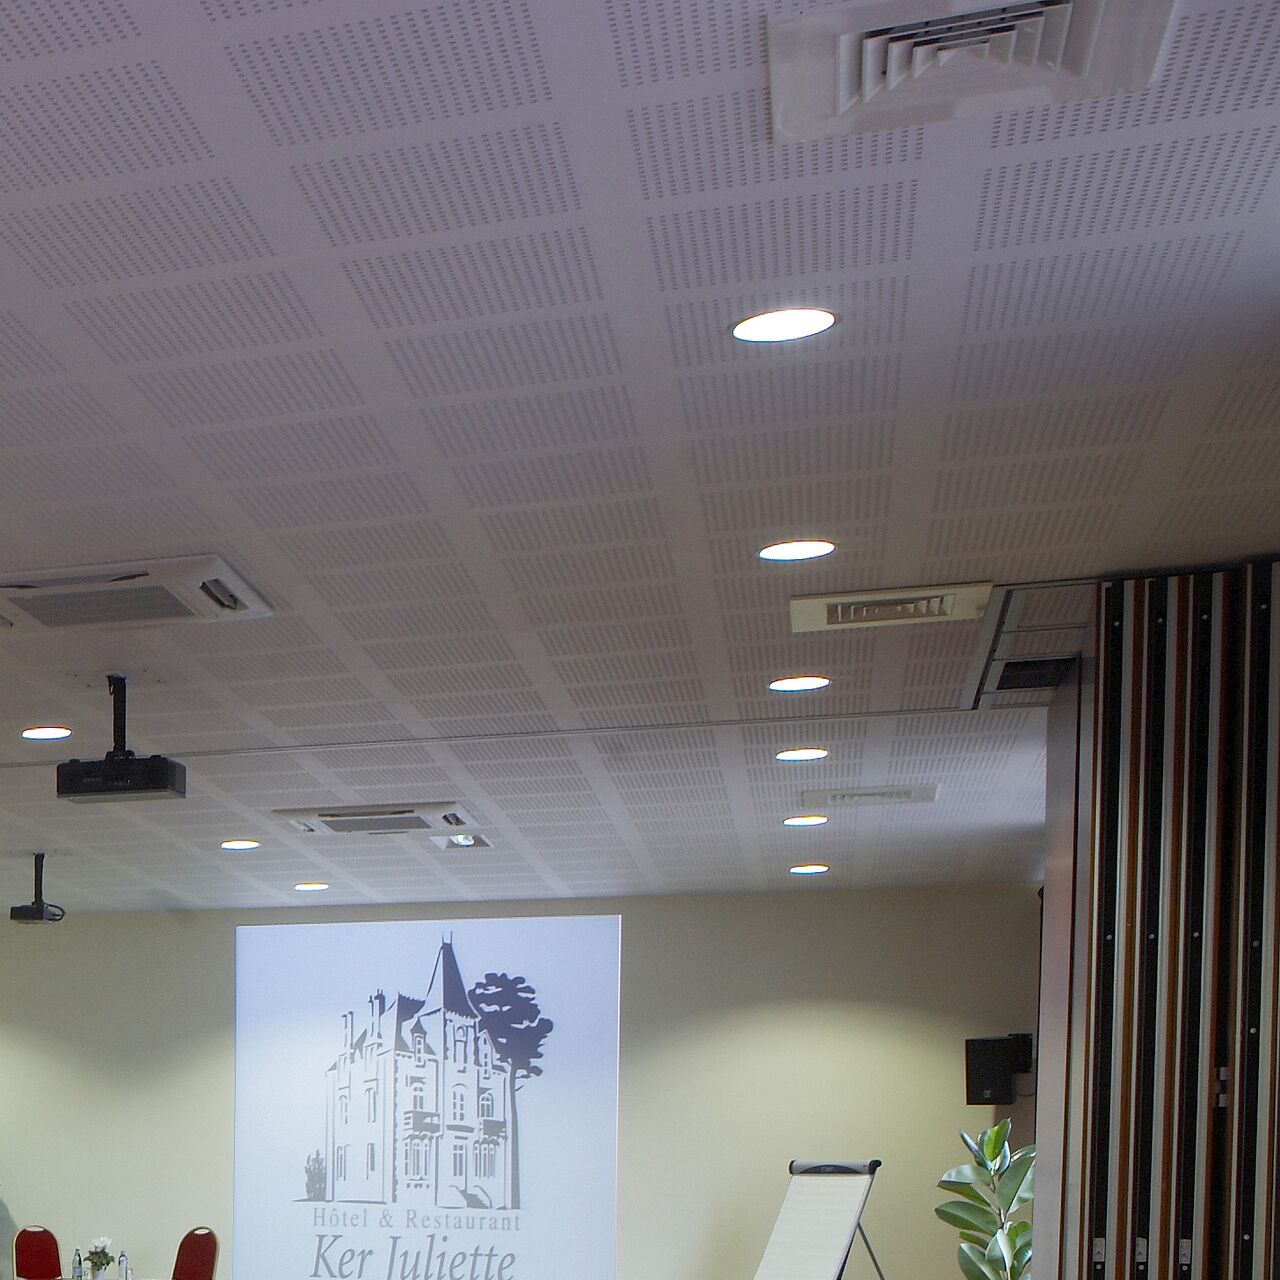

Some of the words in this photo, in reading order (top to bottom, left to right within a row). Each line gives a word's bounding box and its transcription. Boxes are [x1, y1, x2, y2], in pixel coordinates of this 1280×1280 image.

[312, 1207, 368, 1228] Hôtel
[379, 1210, 394, 1229] &
[405, 1208, 521, 1231] Restaurant
[309, 1233, 374, 1280] Ker
